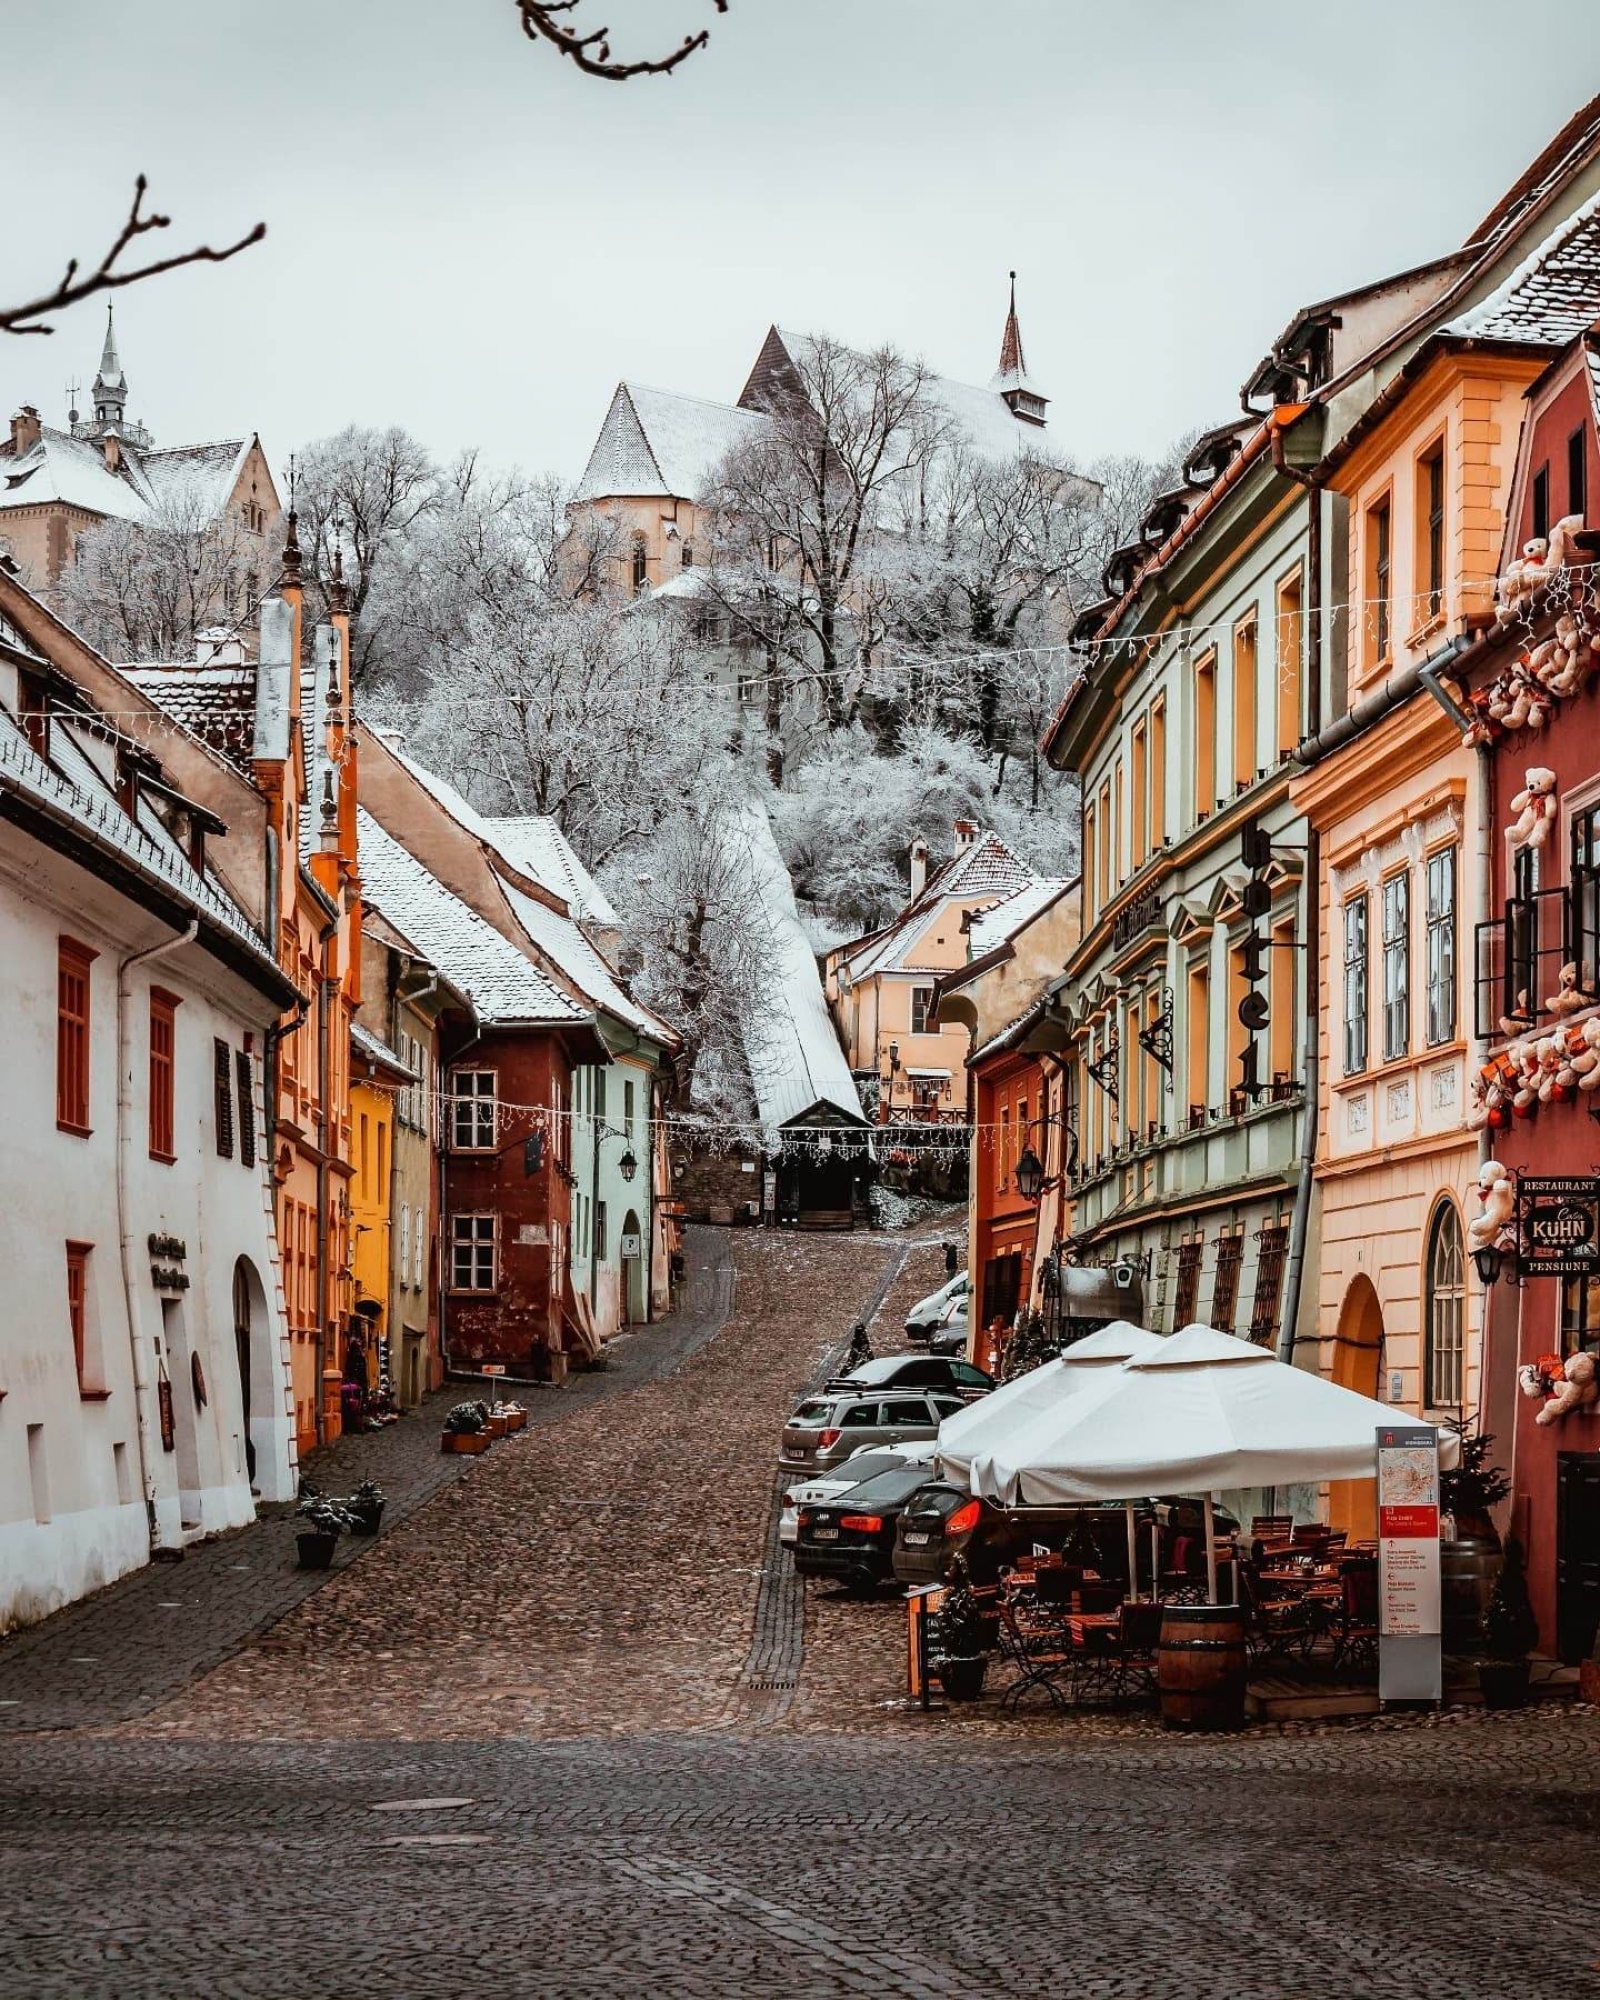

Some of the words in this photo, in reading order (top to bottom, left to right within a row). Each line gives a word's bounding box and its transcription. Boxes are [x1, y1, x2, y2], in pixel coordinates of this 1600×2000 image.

[1236, 816, 1274, 1103] hotel
[1523, 1181, 1596, 1191] RESTAURANT
[1557, 1207, 1584, 1221] Casa
[1528, 1261, 1591, 1272] PENSIUNE
